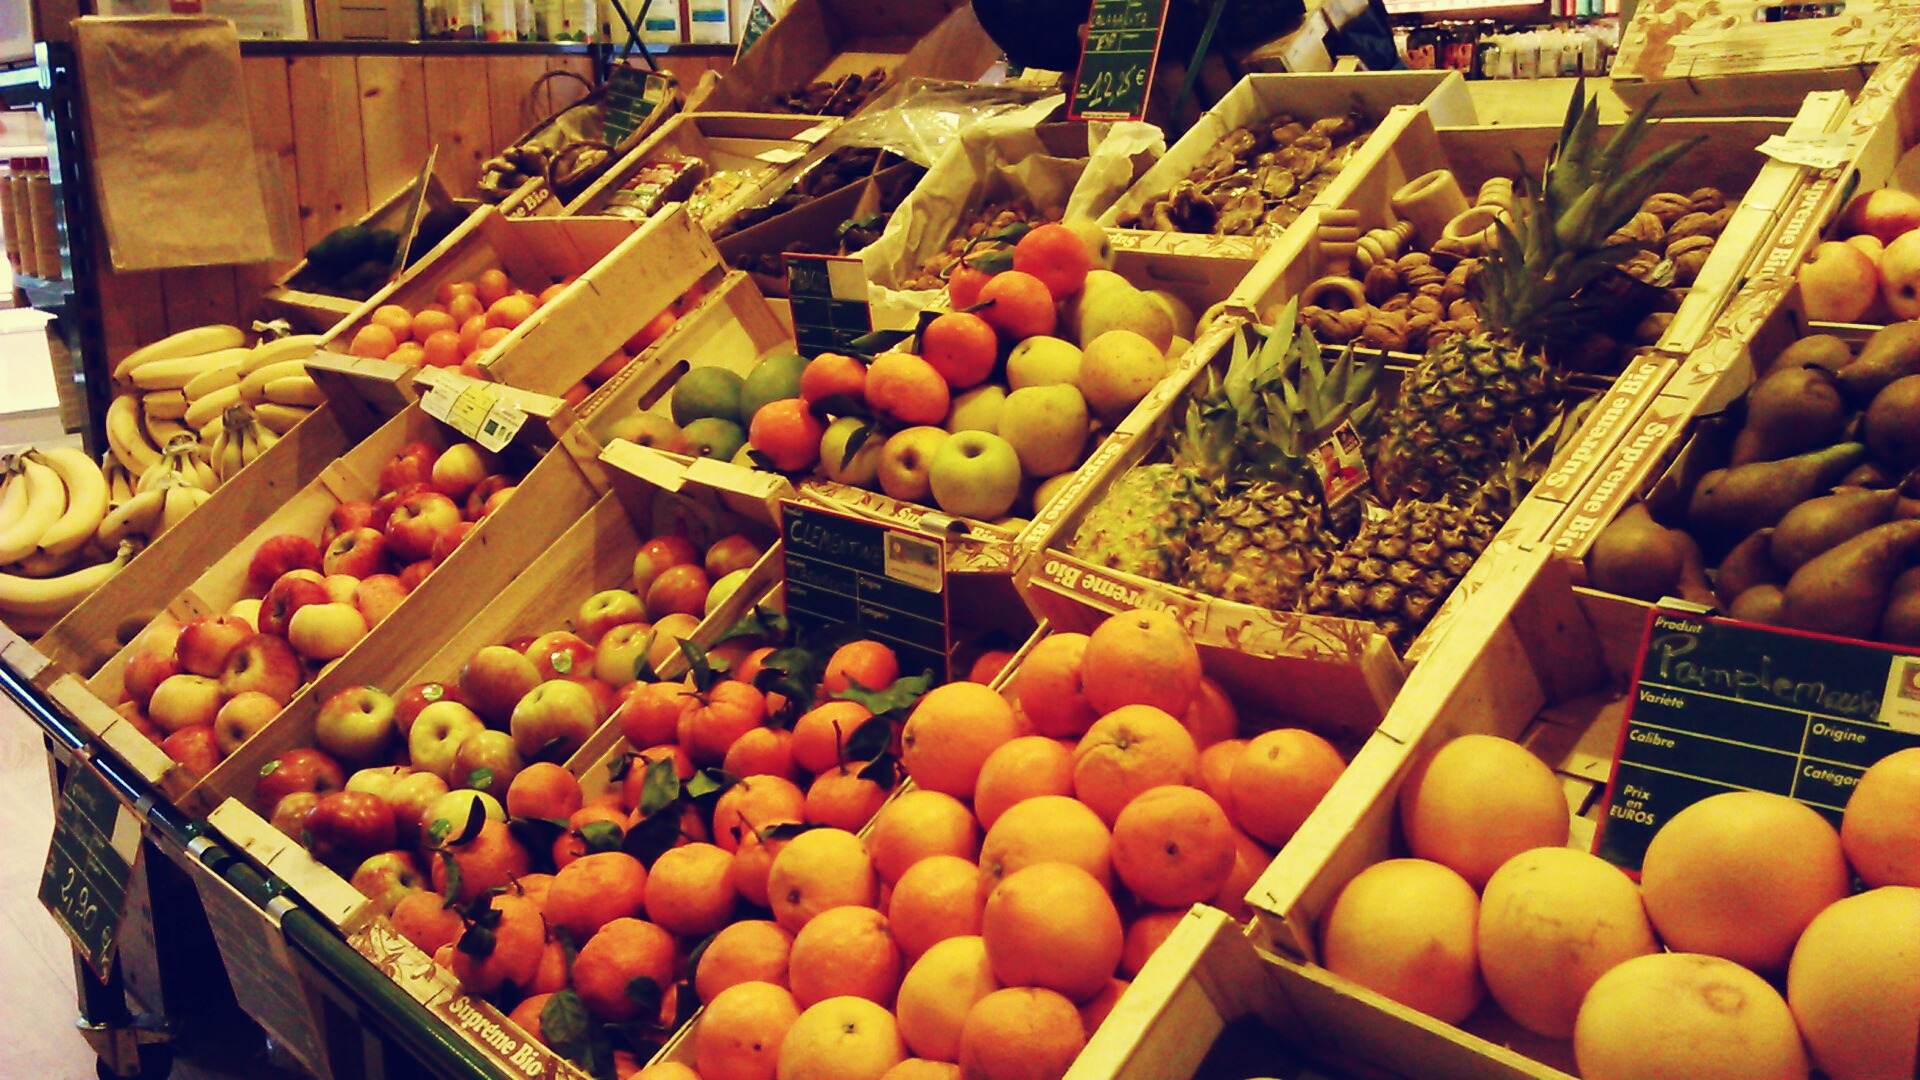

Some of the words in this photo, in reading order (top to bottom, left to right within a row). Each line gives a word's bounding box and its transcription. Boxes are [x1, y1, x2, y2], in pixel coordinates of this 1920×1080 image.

[522, 188, 549, 211] Bio
[1546, 397, 1630, 488] Supreme
[1615, 362, 1659, 396] Bio
[1583, 421, 1669, 513] Supreme
[1045, 441, 1123, 521] Supreme
[1024, 521, 1051, 544] Bi
[1554, 514, 1598, 551] Bio
[1044, 560, 1083, 589] Bio
[1654, 615, 1703, 634] Produit
[1629, 728, 1676, 749] Calibre
[1812, 722, 1867, 745] Origine
[1623, 784, 1650, 800] Prix
[1609, 804, 1655, 826] EUROS
[1626, 798, 1643, 810] en
[509, 1042, 545, 1077] Bio
